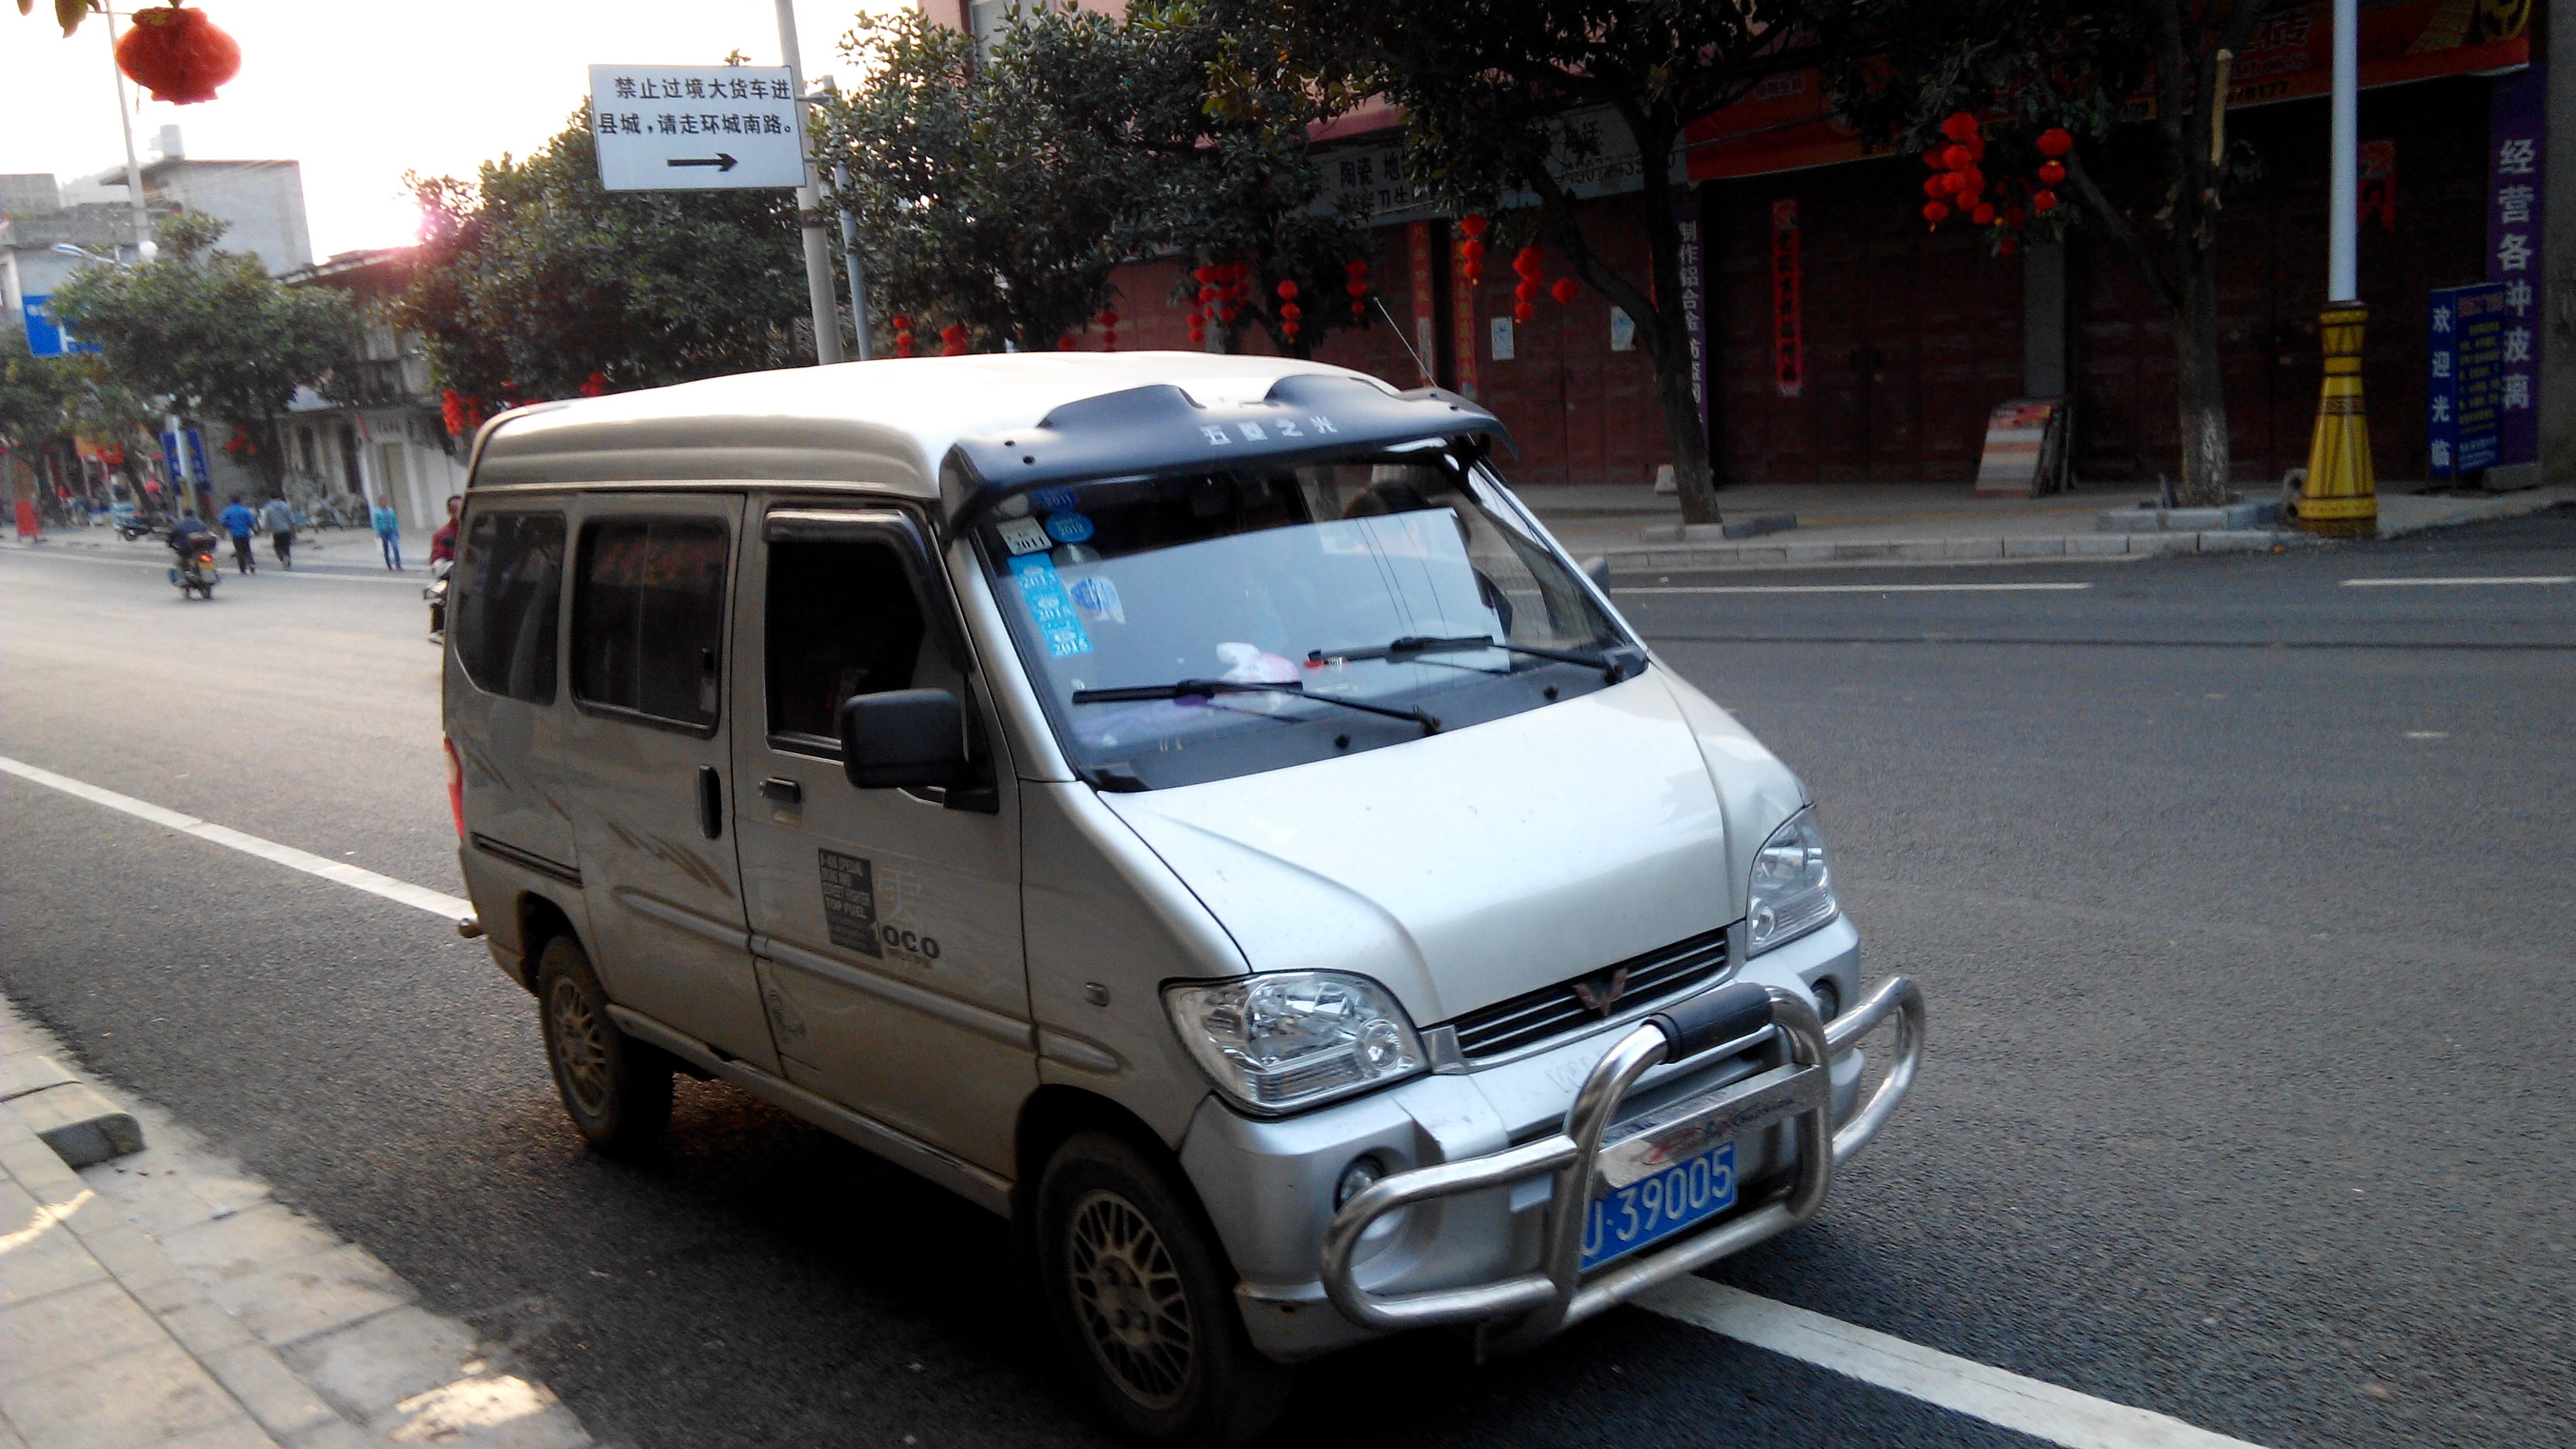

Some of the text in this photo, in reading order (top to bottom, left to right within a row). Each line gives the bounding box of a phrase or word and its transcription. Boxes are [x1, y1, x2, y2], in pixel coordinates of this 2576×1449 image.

[615, 77, 791, 100] 禁止过境大货车进
[598, 113, 792, 135] 县城，请走环城南路。
[2430, 304, 2452, 467] 欢迎光临
